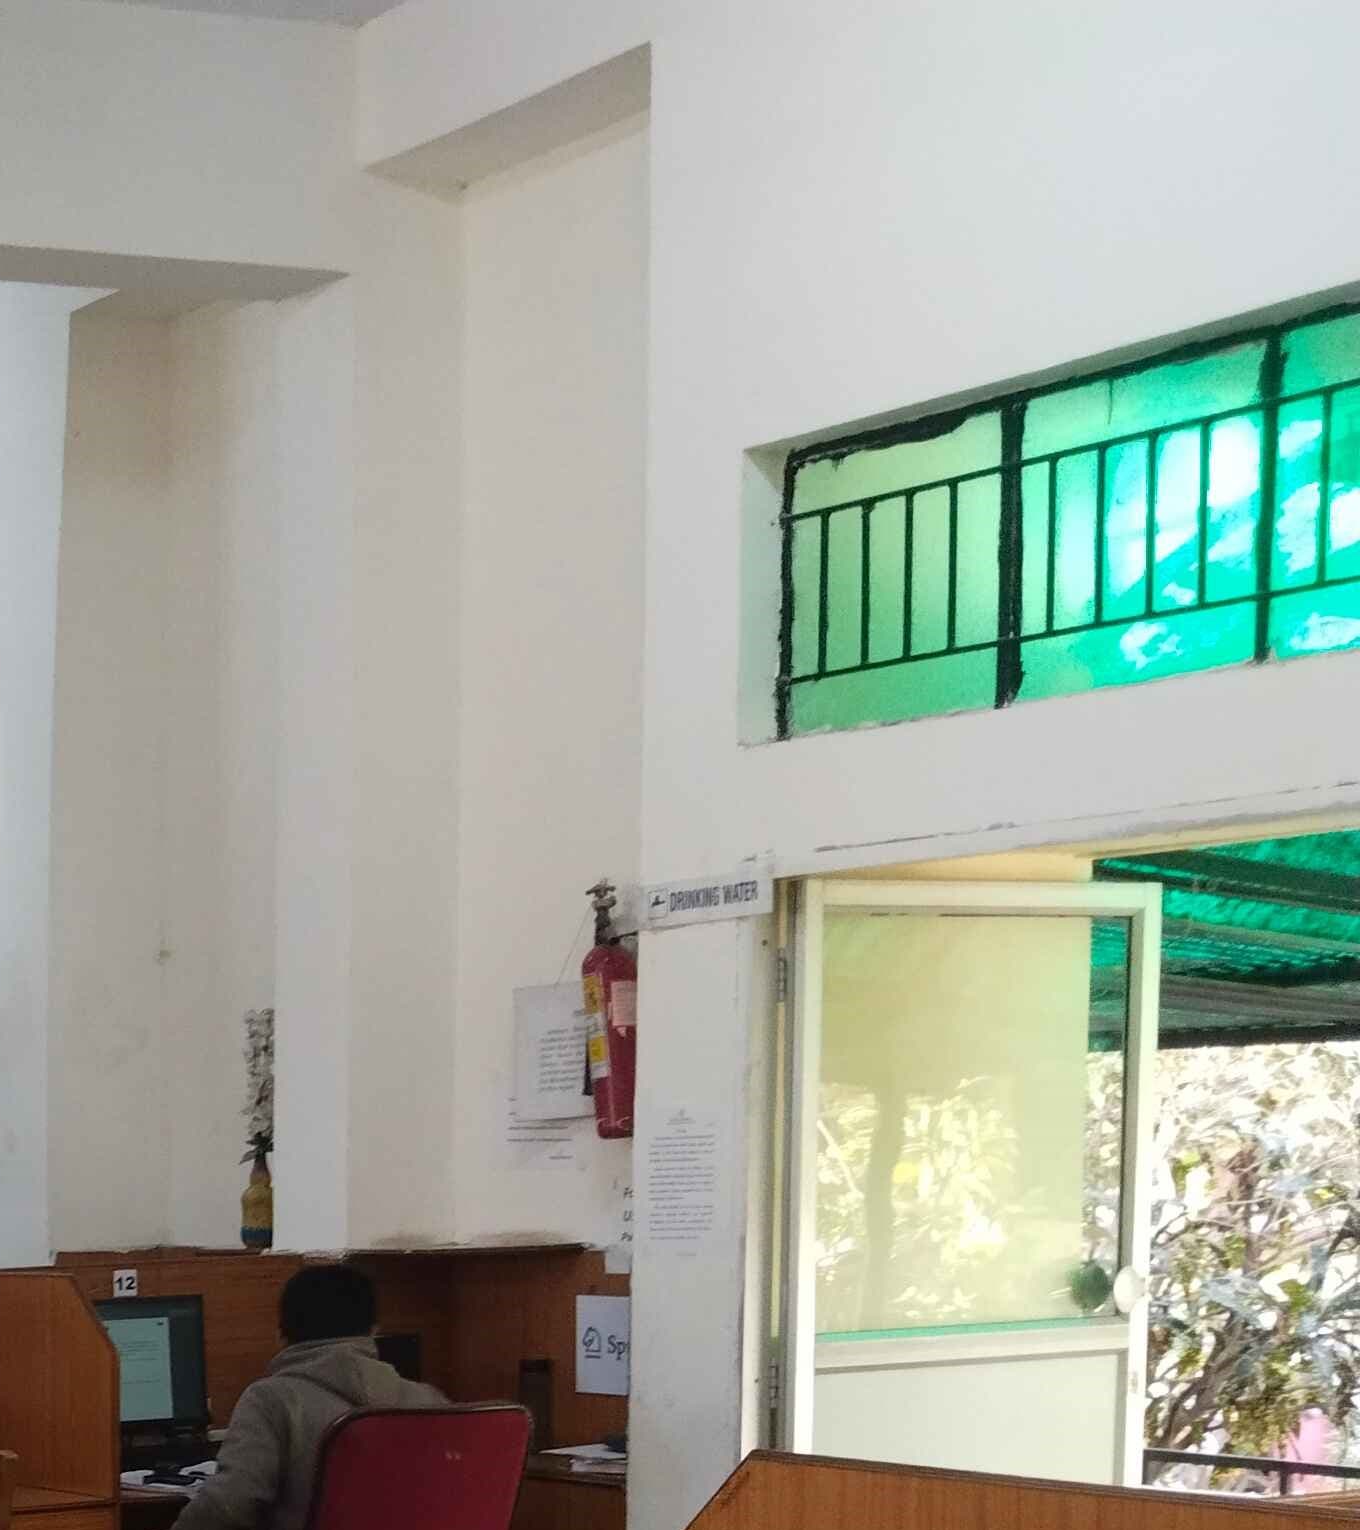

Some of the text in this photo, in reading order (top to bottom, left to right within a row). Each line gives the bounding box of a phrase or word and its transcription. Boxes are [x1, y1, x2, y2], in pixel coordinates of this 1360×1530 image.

[670, 881, 758, 912] DRINKING WATER
[115, 1276, 137, 1291] 12
